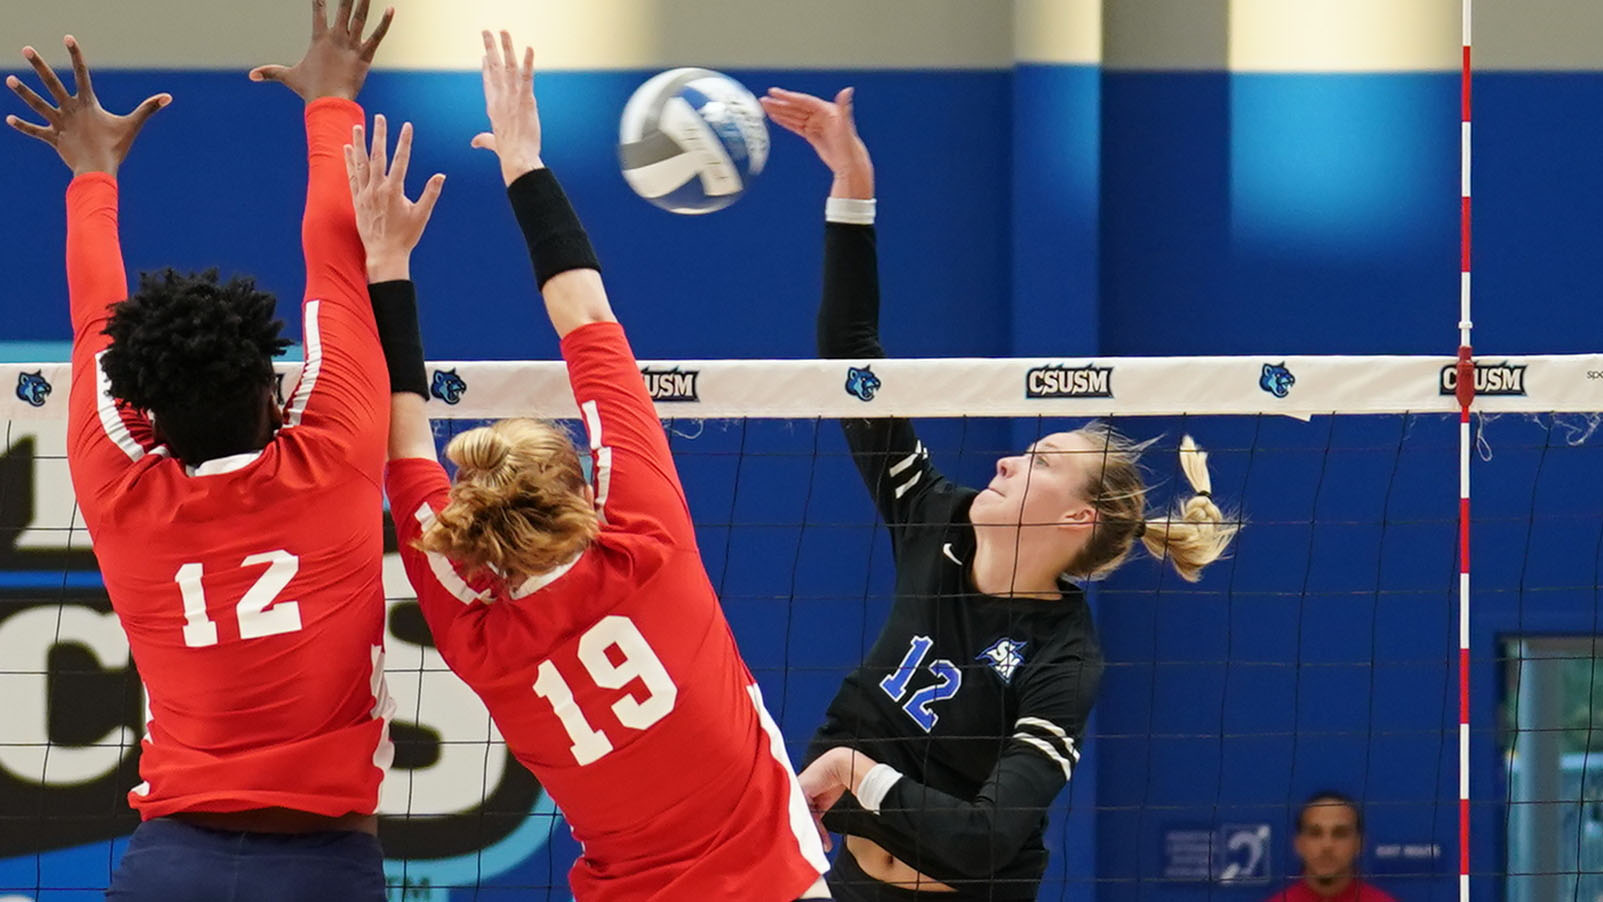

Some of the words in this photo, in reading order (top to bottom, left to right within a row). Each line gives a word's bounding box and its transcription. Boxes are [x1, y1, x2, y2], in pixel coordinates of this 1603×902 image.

[644, 373, 694, 398] USM
[1028, 369, 1109, 396] CSUSM
[1442, 366, 1521, 392] CUSM
[175, 549, 302, 647] 12
[533, 615, 678, 765] 19
[879, 635, 962, 733] 12
